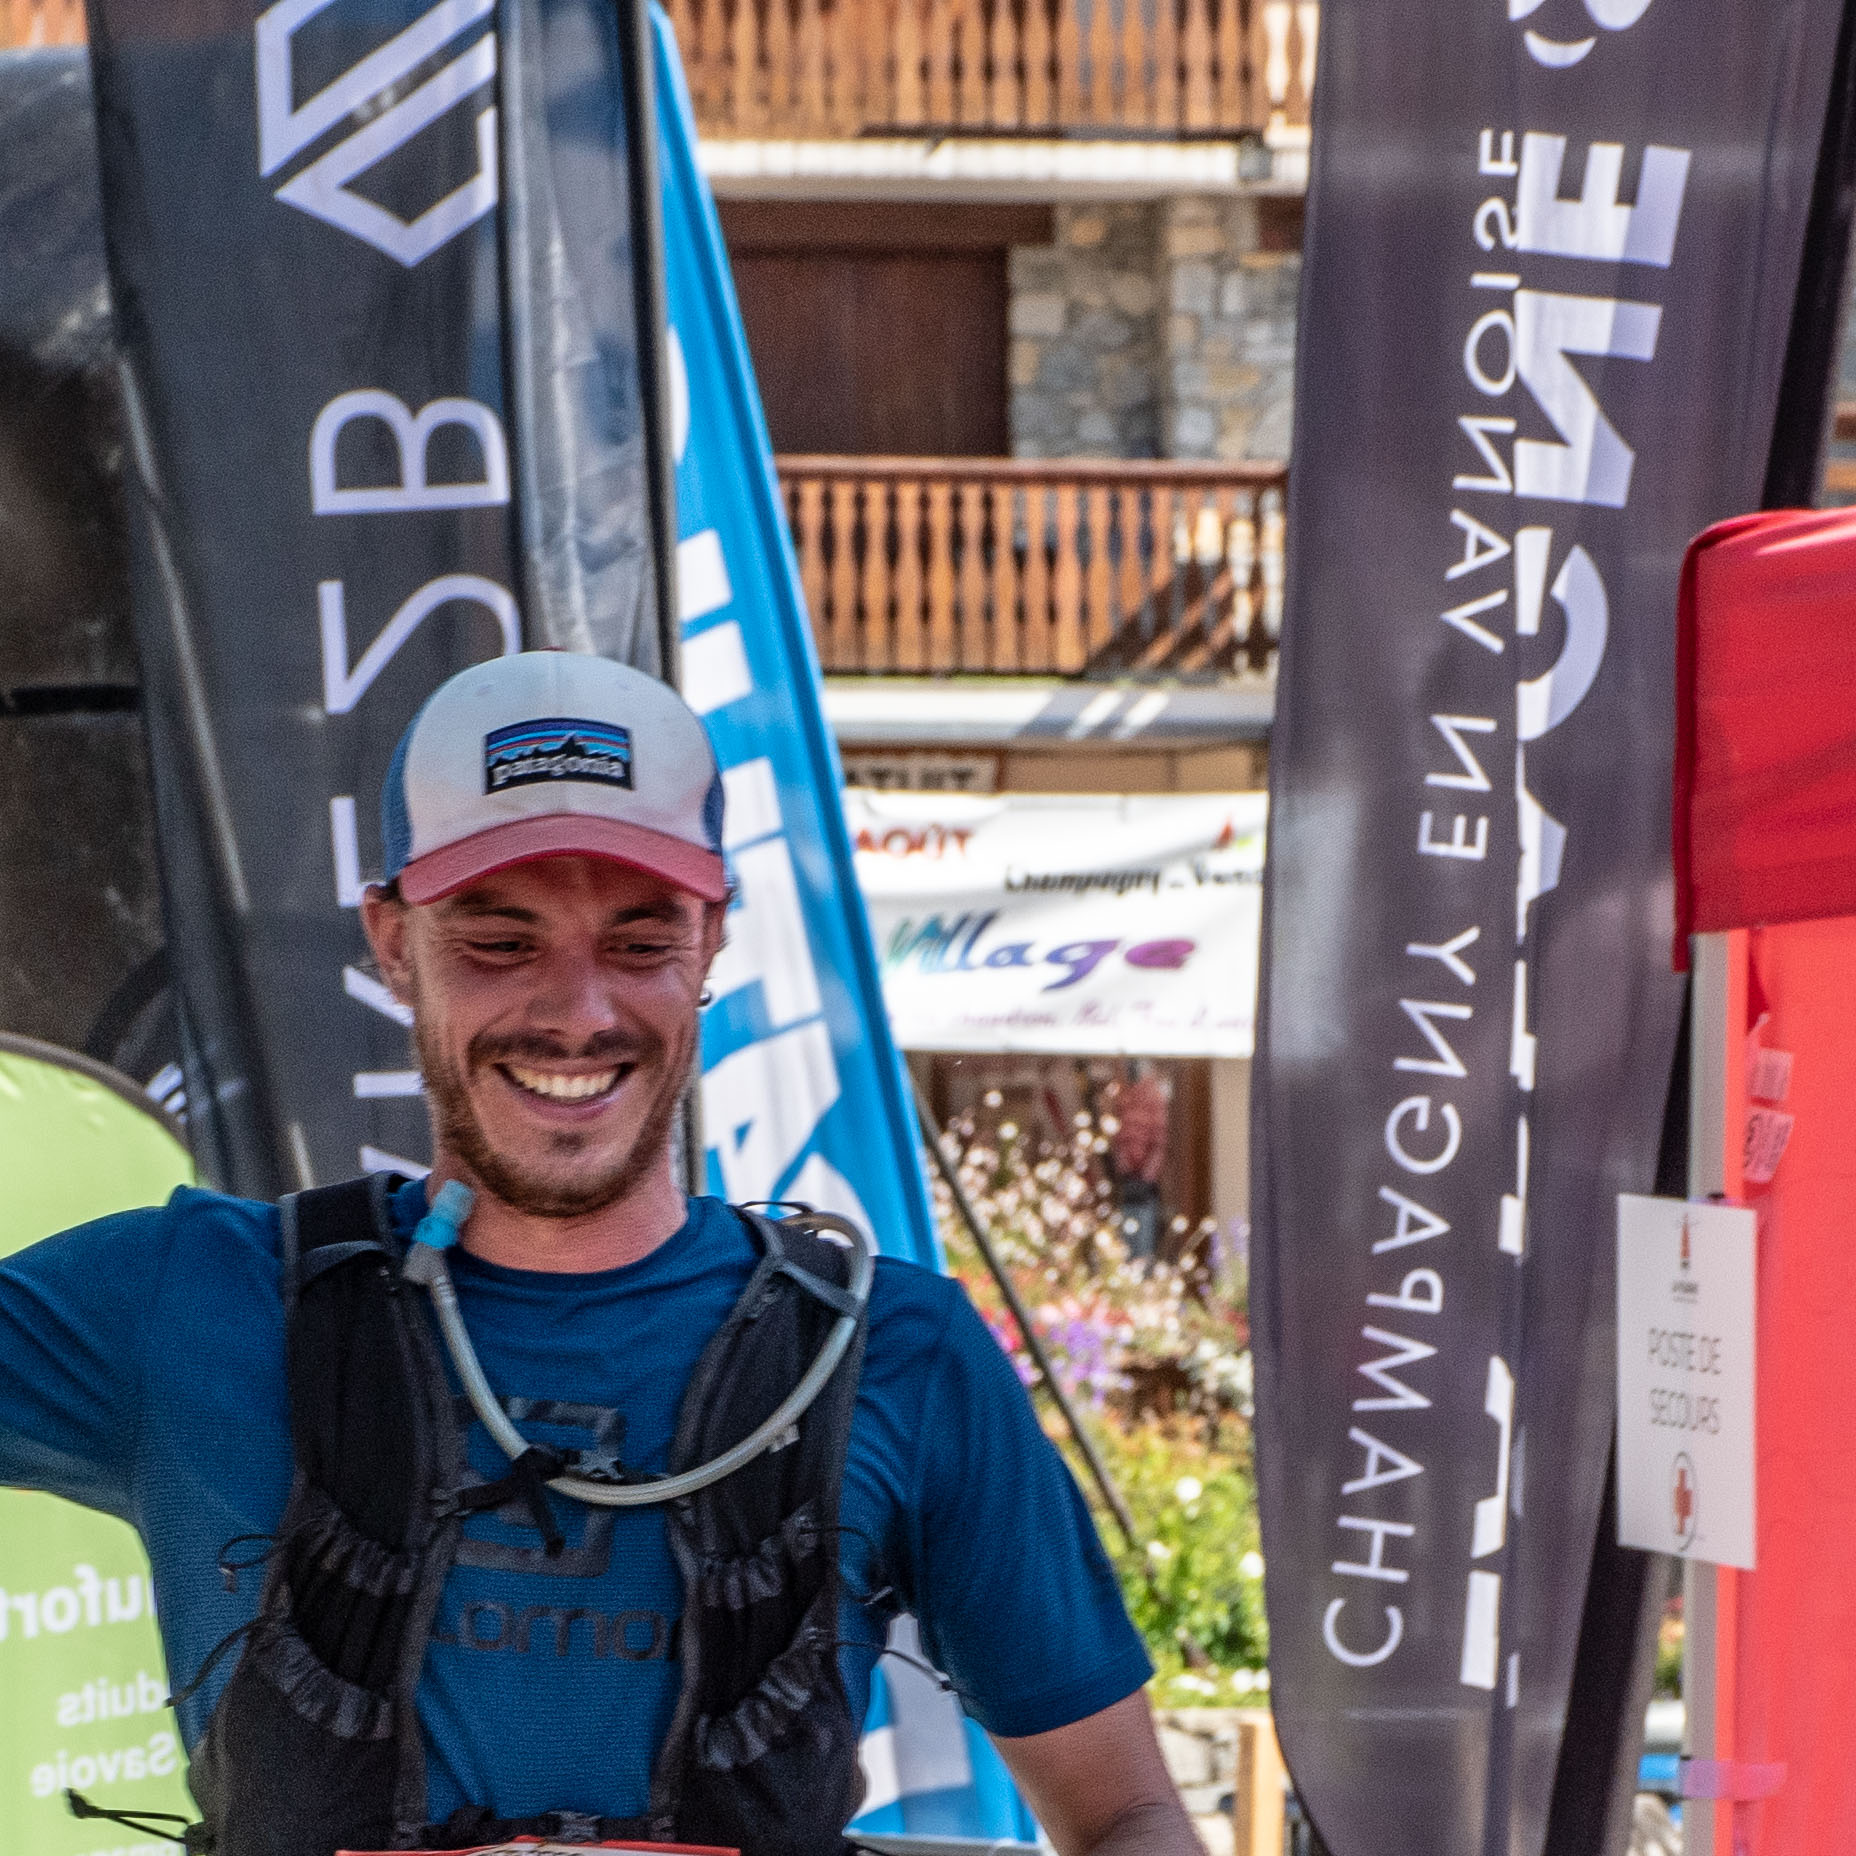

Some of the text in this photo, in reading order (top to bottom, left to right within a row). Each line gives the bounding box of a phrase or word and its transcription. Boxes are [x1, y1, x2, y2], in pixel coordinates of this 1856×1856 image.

[1648, 1327, 1722, 1375] POSTE DE
[1649, 1386, 1721, 1436] SECOURS
